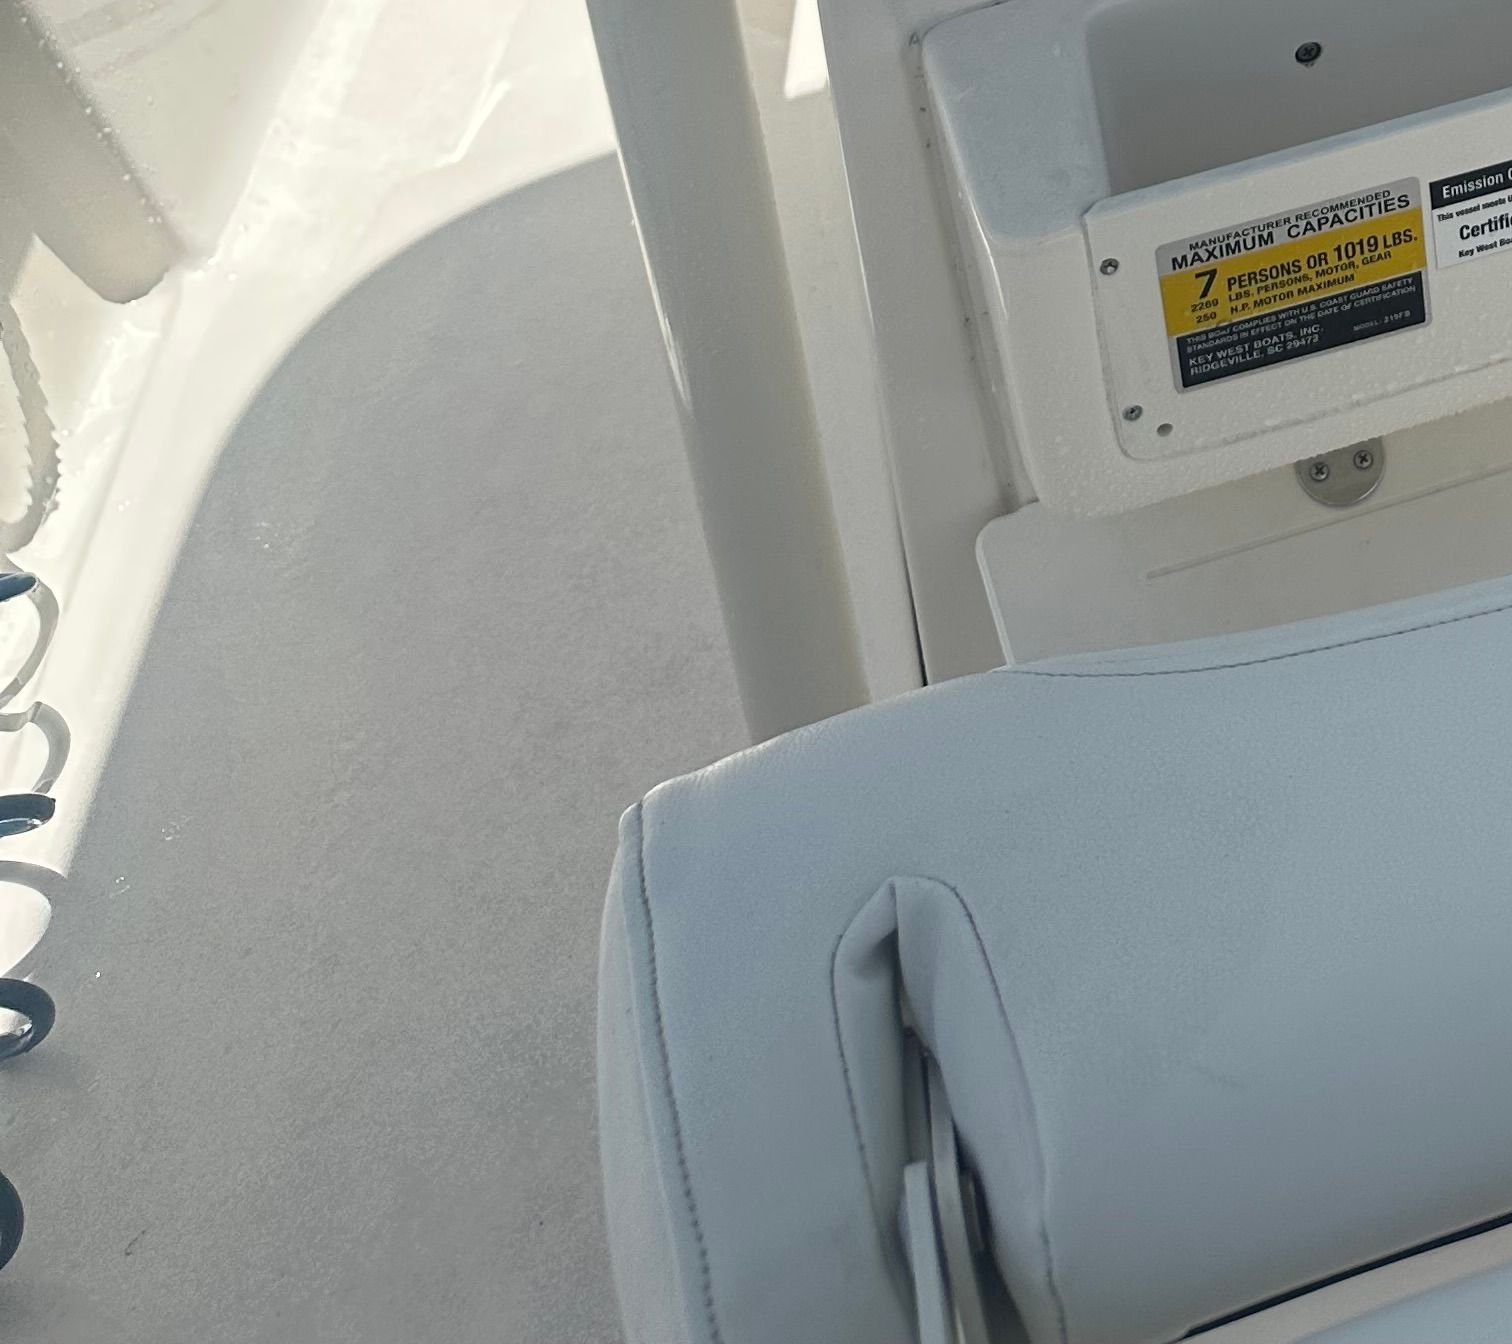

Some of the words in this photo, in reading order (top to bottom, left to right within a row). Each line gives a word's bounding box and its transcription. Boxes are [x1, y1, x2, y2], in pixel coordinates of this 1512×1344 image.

[1442, 173, 1503, 198] Emission
[1171, 231, 1273, 270] MAXIMUM
[1287, 194, 1409, 238] CAPACITIES
[1189, 217, 1291, 250] MANUFACTURER
[1295, 190, 1390, 222] RECOMMENDED
[1436, 212, 1453, 221] This
[1194, 268, 1217, 299] 7
[1227, 259, 1301, 291] PERSONS
[1306, 251, 1328, 269] OR
[1333, 235, 1378, 261] 1019
[1382, 228, 1417, 249] LBS.
[1458, 248, 1474, 258] Key
[1475, 240, 1497, 252] West
[1253, 290, 1294, 308] MOTOR
[1297, 273, 1354, 296] MAXIMUM
[1256, 273, 1312, 294] PERSONS,
[1315, 260, 1359, 278] MOTOR,
[1361, 250, 1391, 265] GEAR
[1186, 333, 1206, 344] THIS
[1207, 326, 1231, 339] BOAT
[1232, 315, 1276, 332] COMPLIES
[1277, 308, 1300, 319] WITH
[1319, 295, 1347, 308] COAST
[1349, 286, 1380, 300] GUARD
[1381, 276, 1413, 291] SAFETY
[1186, 333, 1238, 353] STANDARDS
[1239, 330, 1249, 338] IN
[1250, 321, 1281, 335] EFFECT
[1284, 317, 1297, 326] ON
[1298, 312, 1315, 321] THE
[1317, 305, 1339, 317] DATE
[1340, 302, 1352, 311] OF
[1353, 285, 1415, 307] CERTIFICATION
[1188, 352, 1213, 366] KEY
[1216, 342, 1249, 358] WEST
[1266, 343, 1283, 354] SC
